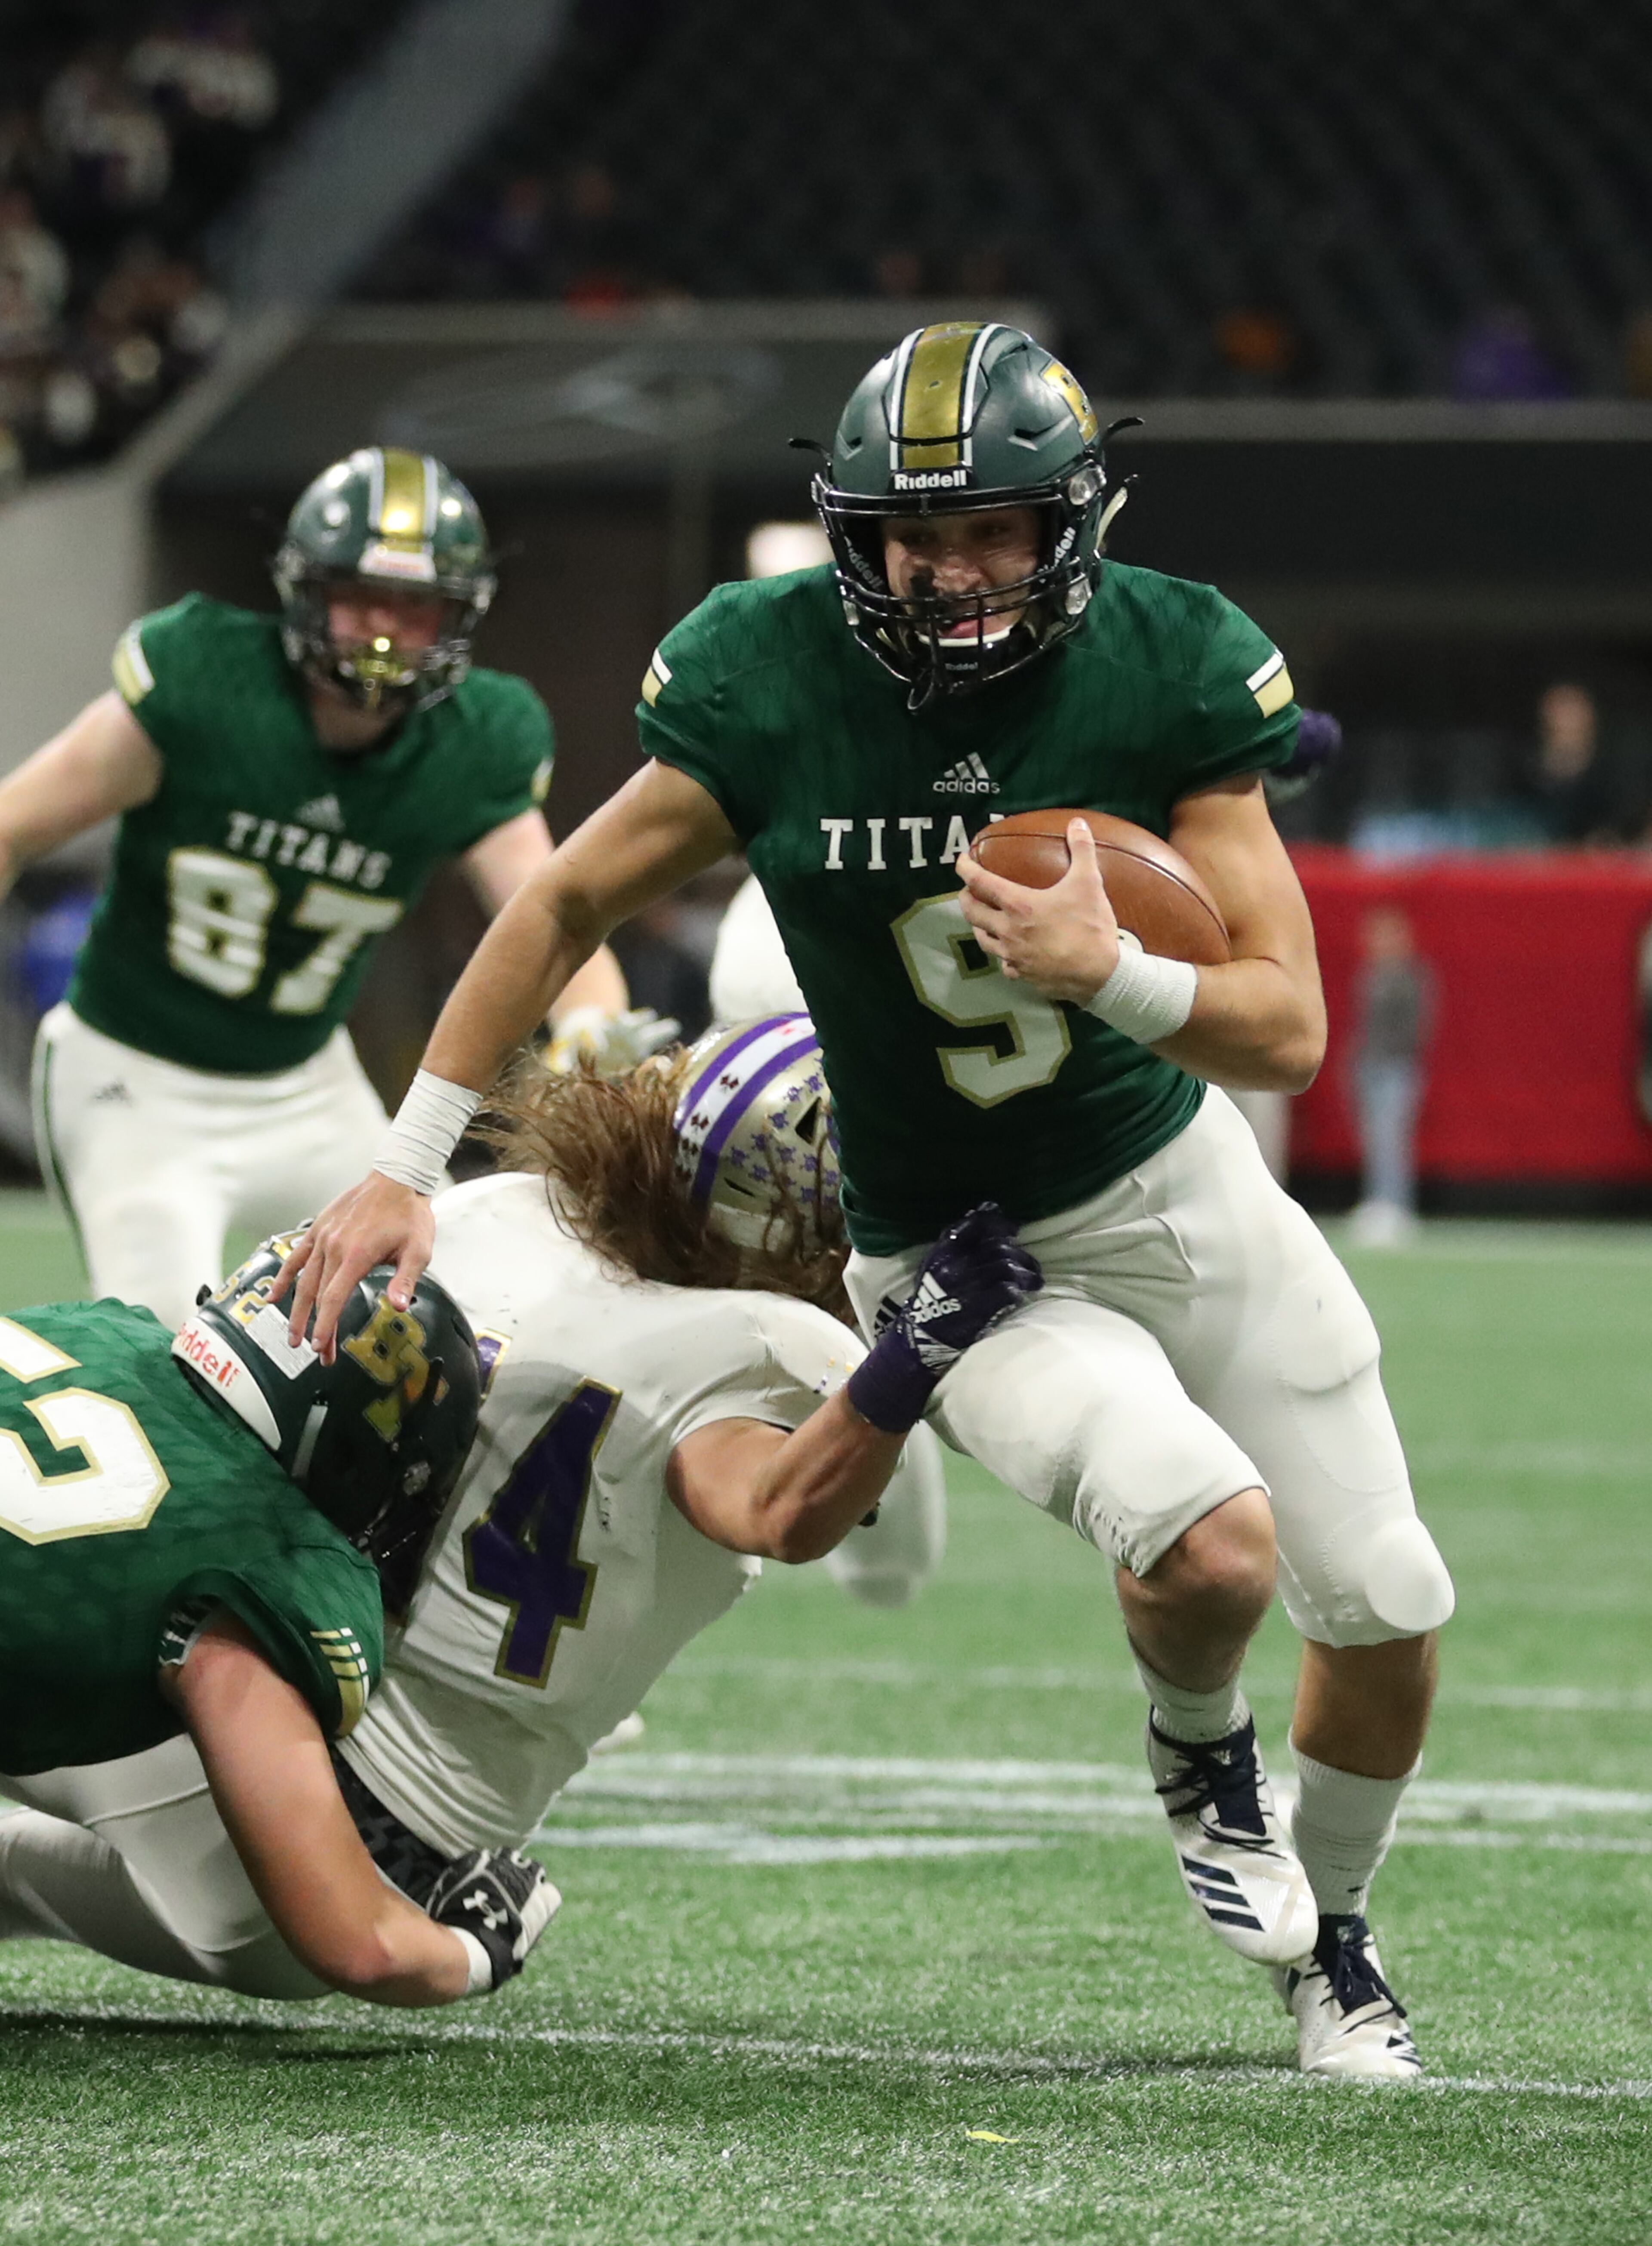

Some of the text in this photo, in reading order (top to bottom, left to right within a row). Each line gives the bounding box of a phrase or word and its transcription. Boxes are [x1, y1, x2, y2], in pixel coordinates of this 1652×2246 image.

[894, 470, 967, 490] Riddell
[933, 777, 1000, 794] adidas
[227, 811, 391, 889] TITANS
[820, 813, 1005, 870] TITA
[167, 845, 404, 1015] 87
[889, 884, 1072, 1109] 9
